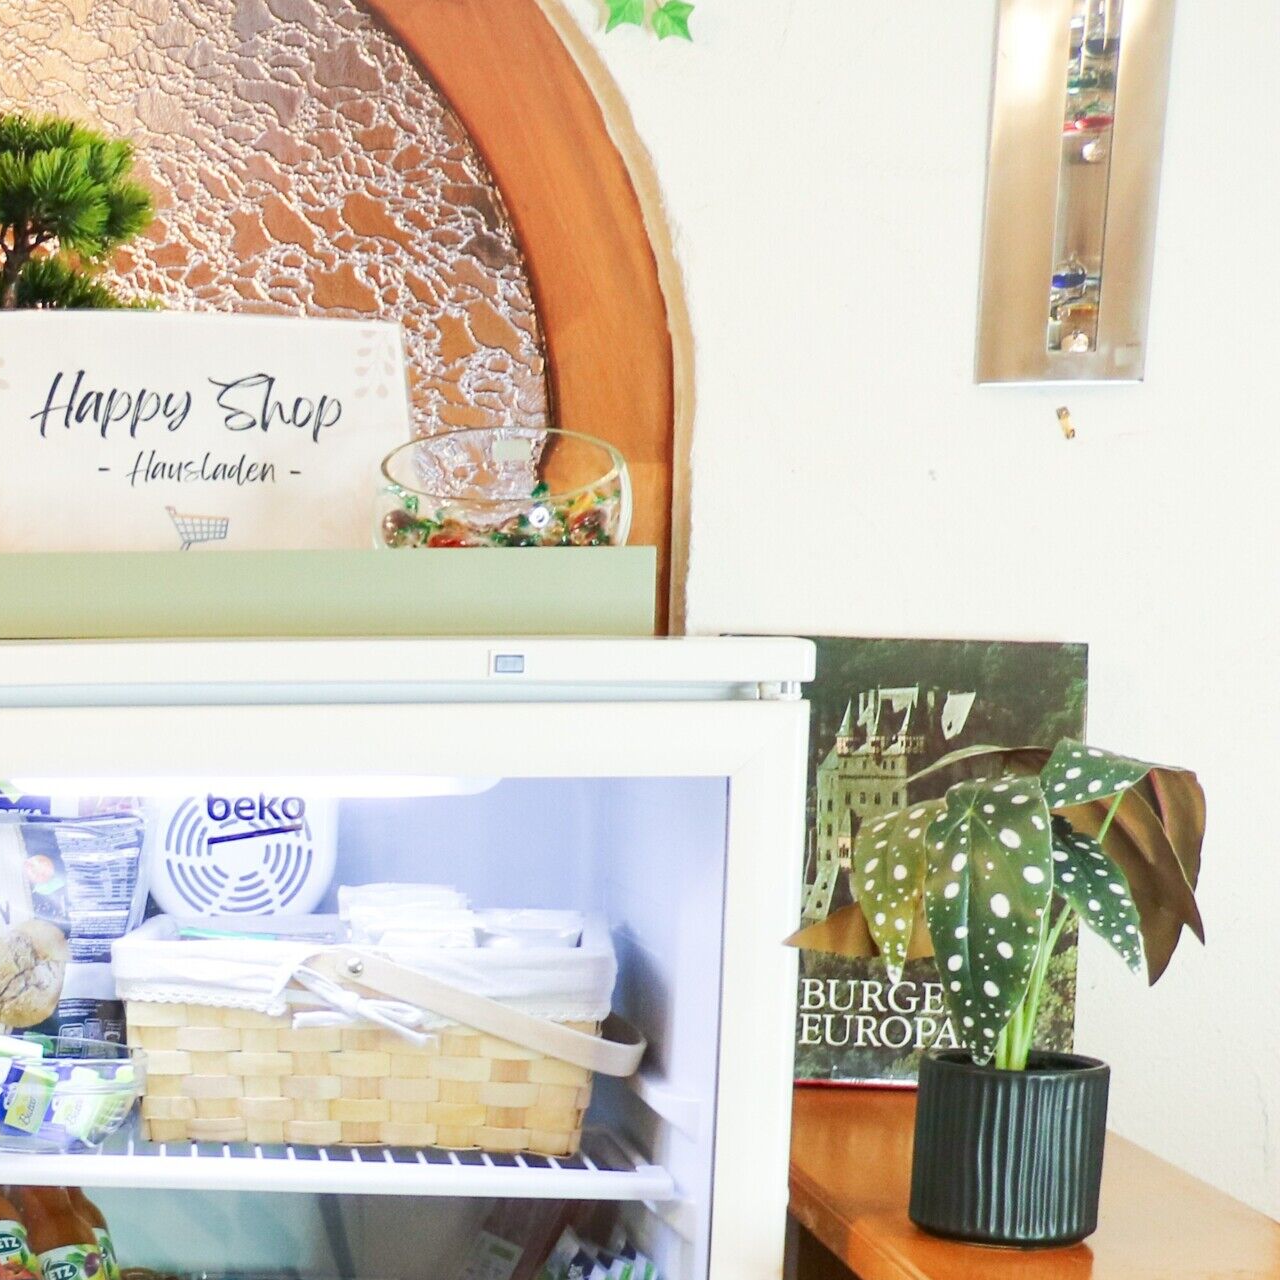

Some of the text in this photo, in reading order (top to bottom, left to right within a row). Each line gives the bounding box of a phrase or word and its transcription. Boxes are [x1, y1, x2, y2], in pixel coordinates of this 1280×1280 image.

[30, 369, 342, 443] Happy Shop
[126, 449, 276, 488] Hausladen
[206, 791, 306, 822] beko
[799, 978, 952, 1015] BURGE
[798, 1013, 968, 1050] EUROPA
